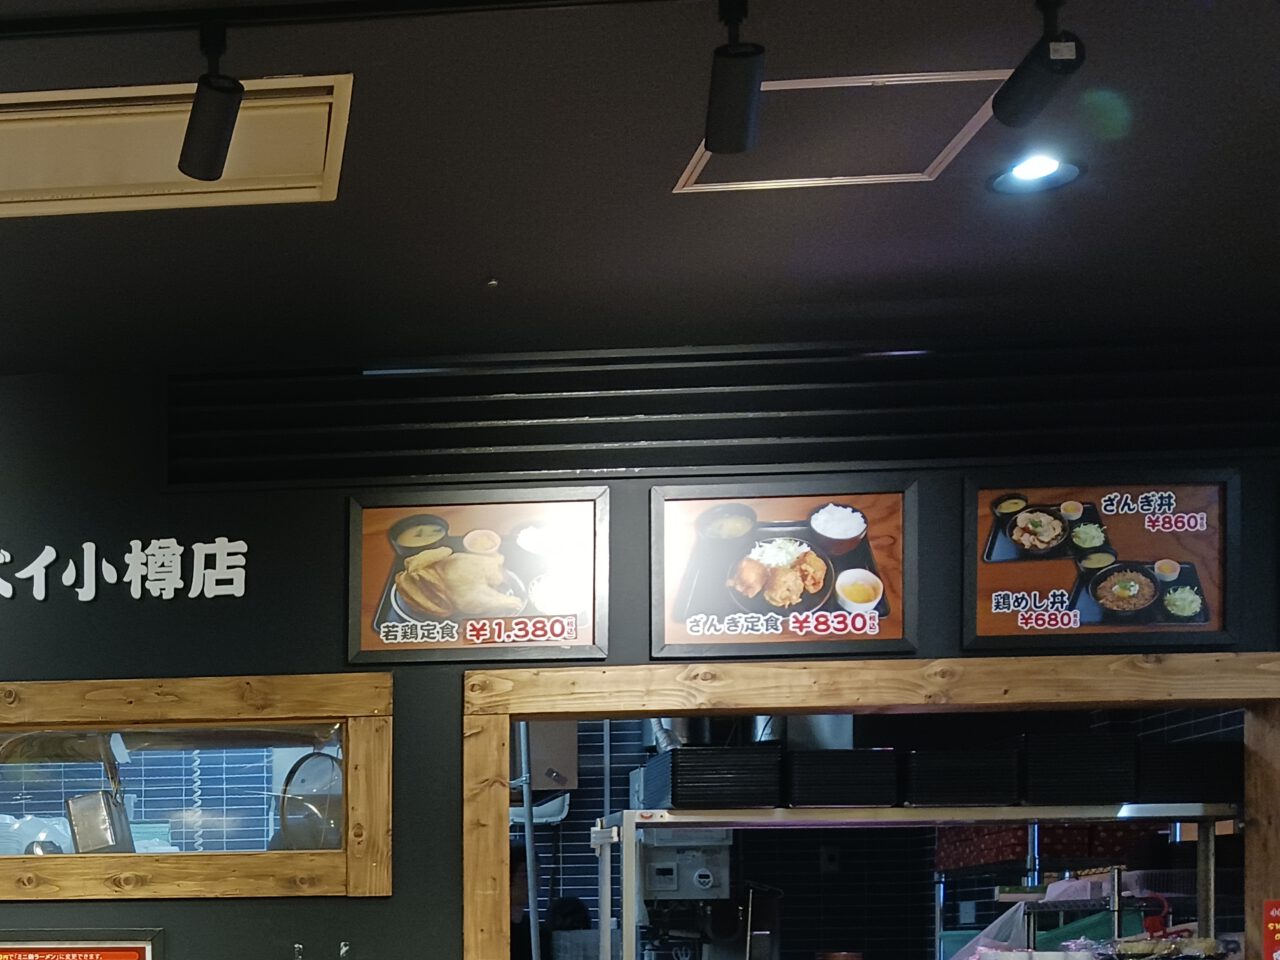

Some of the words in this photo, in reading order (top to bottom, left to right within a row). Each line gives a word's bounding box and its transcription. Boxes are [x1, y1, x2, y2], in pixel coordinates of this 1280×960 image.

[1102, 493, 1175, 513] ざんぎ丼
[1146, 514, 1198, 530] ¥860
[992, 591, 1069, 612] 鶏めし丼
[688, 614, 781, 633] ざんぎ定食
[792, 613, 867, 633] ¥830
[1020, 612, 1072, 628] ¥680
[382, 623, 457, 641] 若鶏定食
